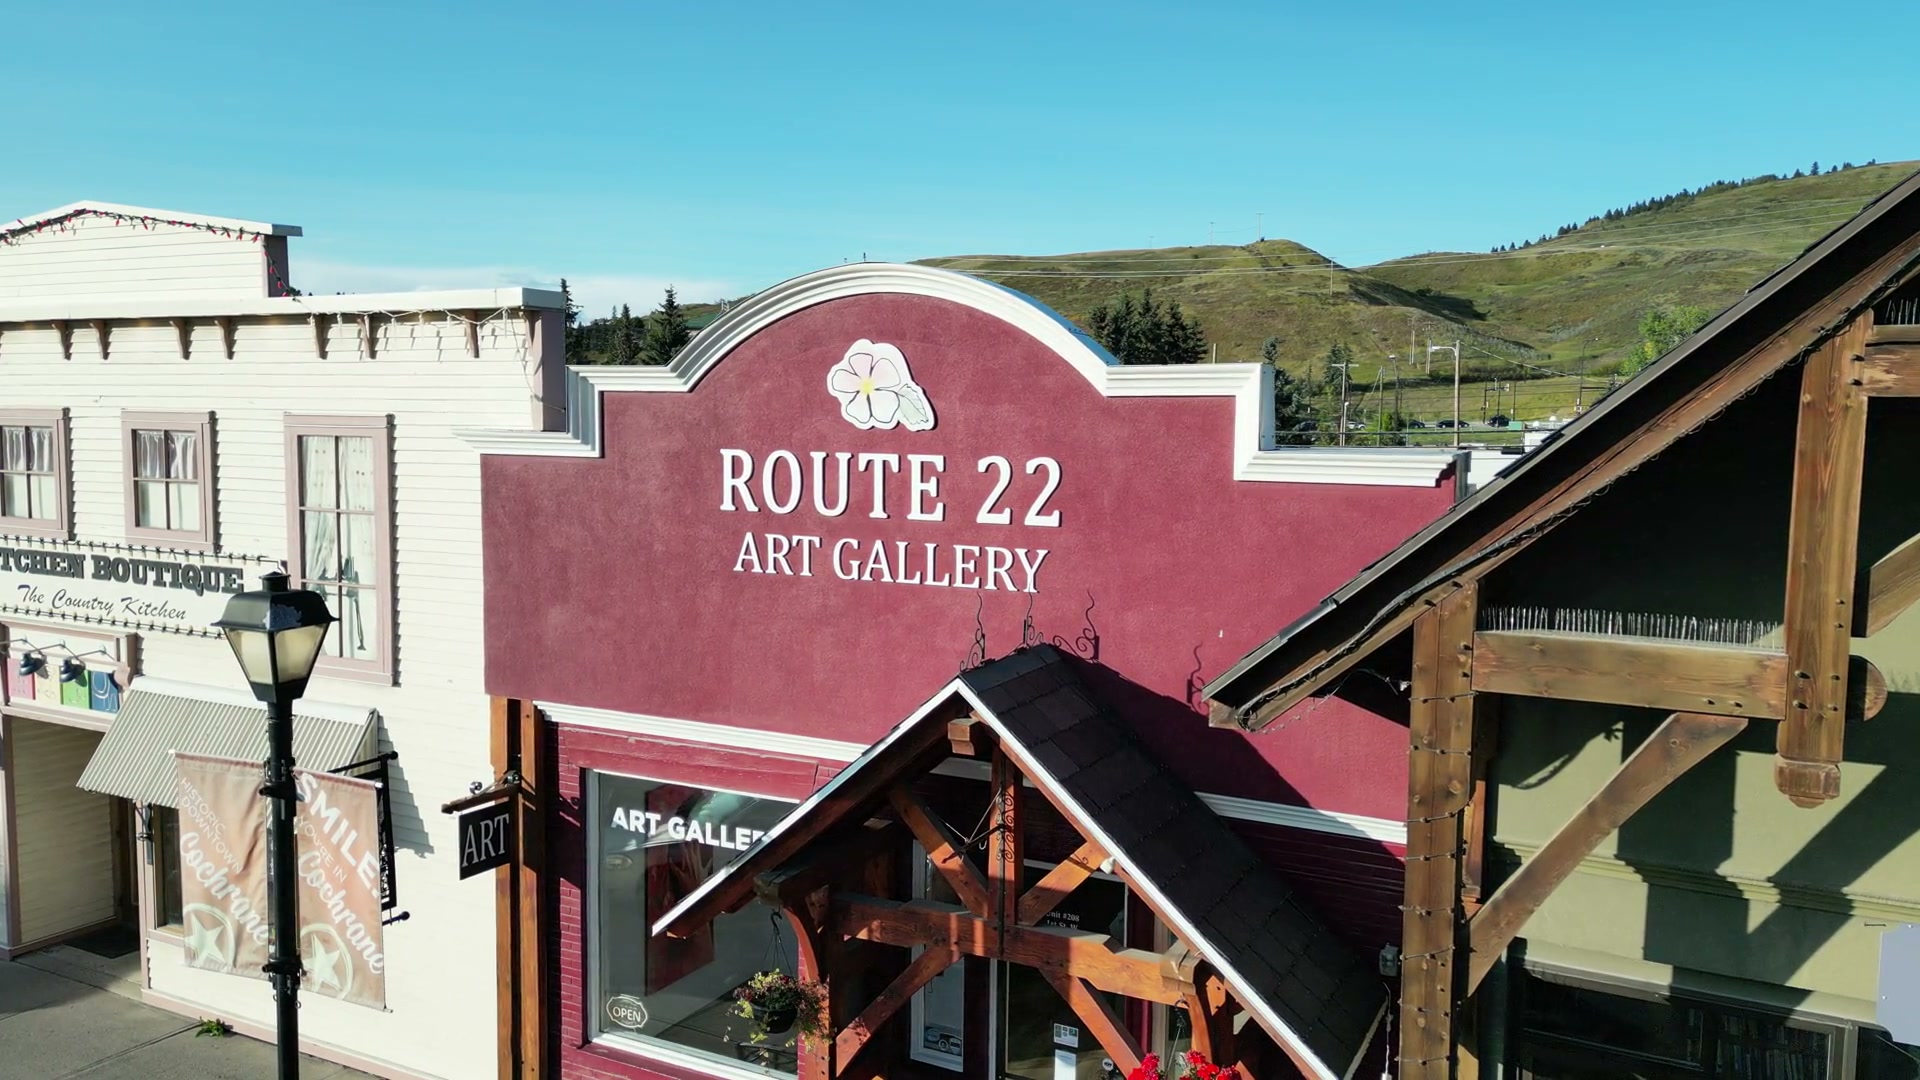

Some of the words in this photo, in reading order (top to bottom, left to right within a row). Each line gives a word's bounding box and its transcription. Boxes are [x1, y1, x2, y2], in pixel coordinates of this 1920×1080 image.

[719, 448, 945, 522] ROUTE
[975, 455, 1063, 528] 22
[90, 554, 245, 597] BOUTIQUE
[733, 531, 823, 577] ART
[832, 538, 1050, 594] GALLERY
[17, 584, 45, 604] The
[51, 588, 114, 616] Country
[120, 596, 187, 620] Kitchen
[180, 776, 226, 835] HISTORIC
[610, 806, 662, 837] ART
[180, 794, 243, 875] DOWNTOWN
[461, 813, 509, 868] ART
[180, 831, 269, 946] Cochrane
[332, 864, 348, 883] IN
[298, 850, 384, 975] Cochrane
[612, 1006, 641, 1023] OPEN
